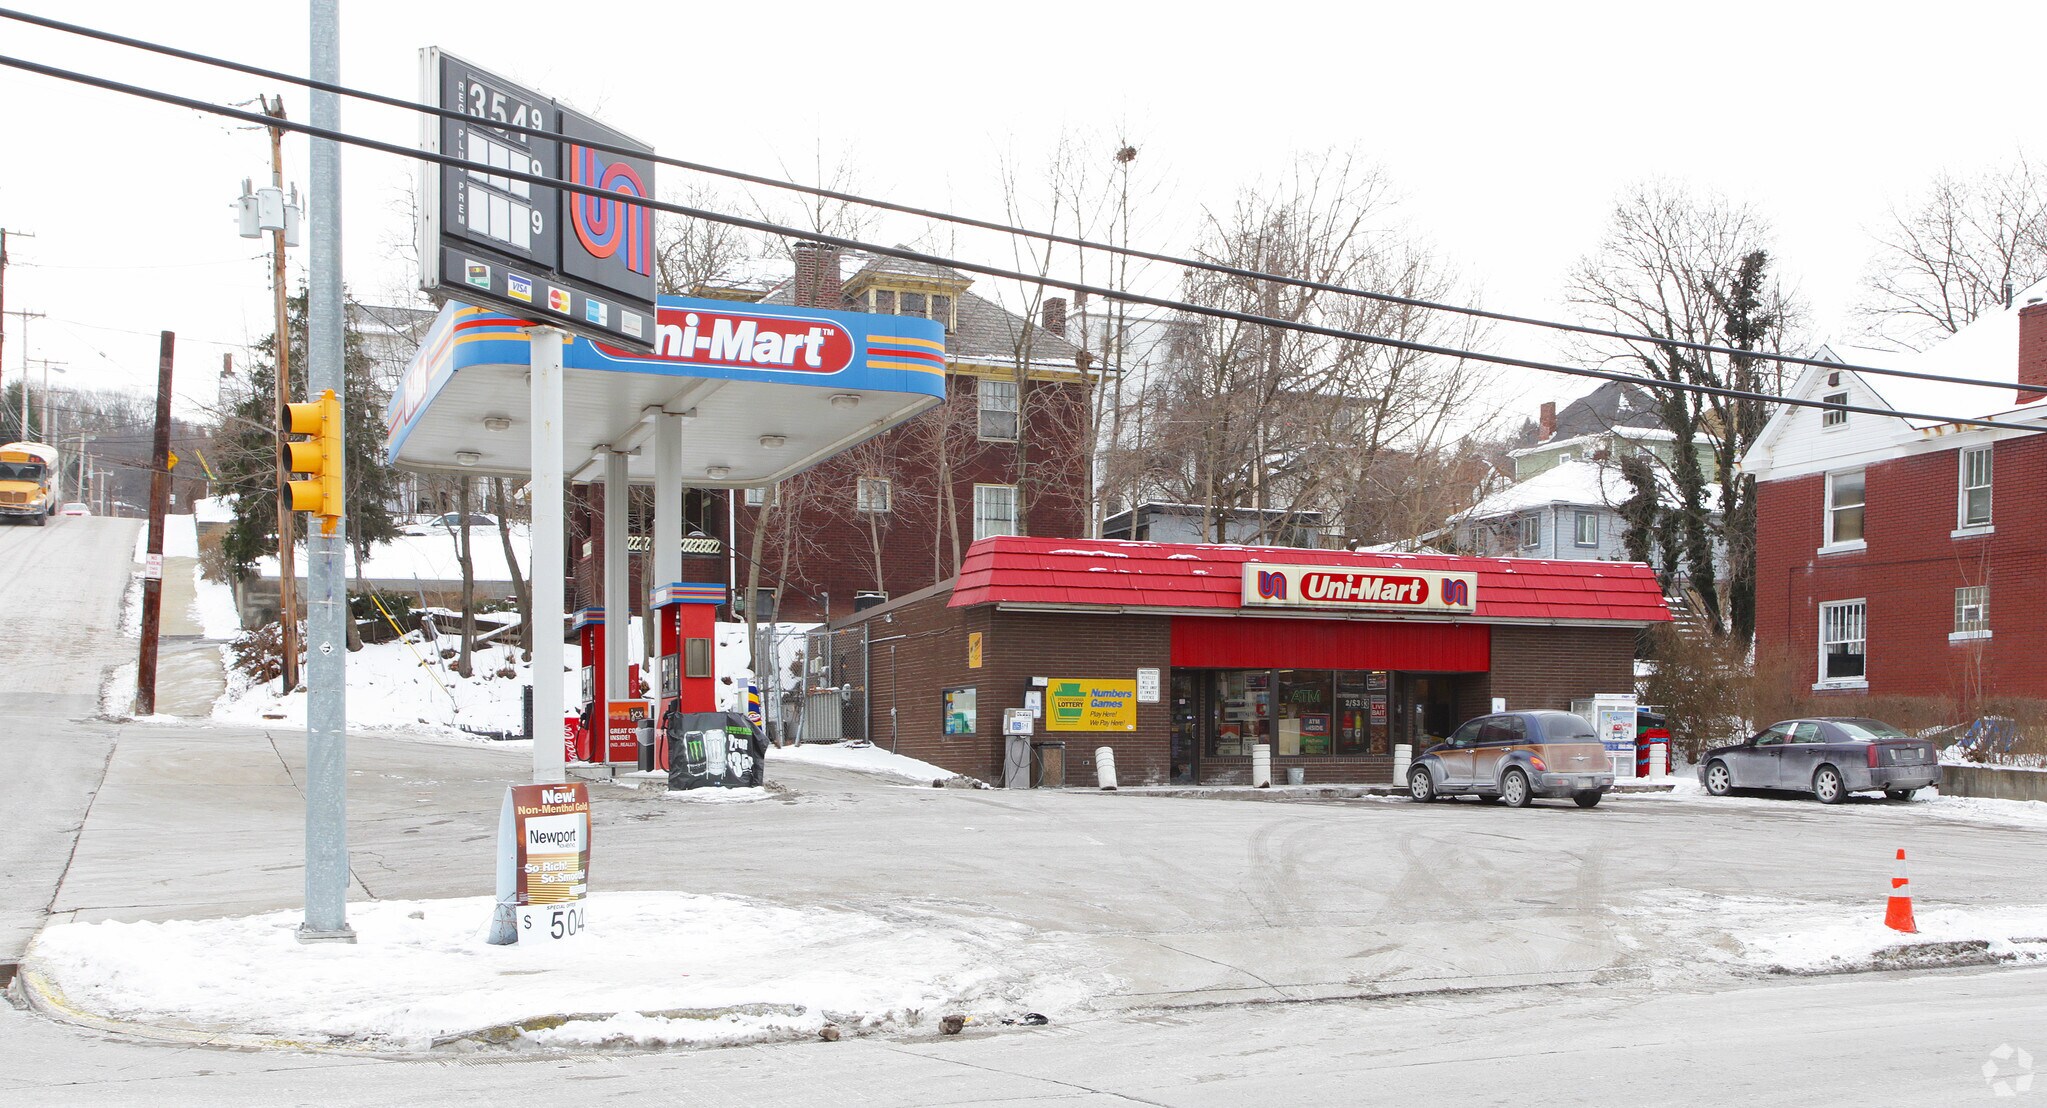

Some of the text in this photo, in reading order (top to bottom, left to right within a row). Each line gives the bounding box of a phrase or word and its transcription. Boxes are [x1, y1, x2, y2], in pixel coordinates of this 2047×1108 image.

[531, 210, 543, 235] 9
[512, 281, 528, 295] VISA
[656, 312, 824, 368] ni-Mart
[1308, 574, 1421, 602] Uni-Mart
[1090, 688, 1133, 699] Numbers
[1291, 690, 1321, 703] ATM
[1090, 698, 1124, 708] Games
[1090, 711, 1102, 719] Play
[1371, 709, 1385, 717] BAIT
[1100, 719, 1111, 728] Pay
[1111, 719, 1126, 727] Here!
[541, 788, 576, 805] New!
[517, 801, 588, 815] Non-Menthol Gold
[530, 828, 576, 846] Newport
[524, 860, 568, 874] So Rich!
[541, 869, 585, 884] So Smooth!
